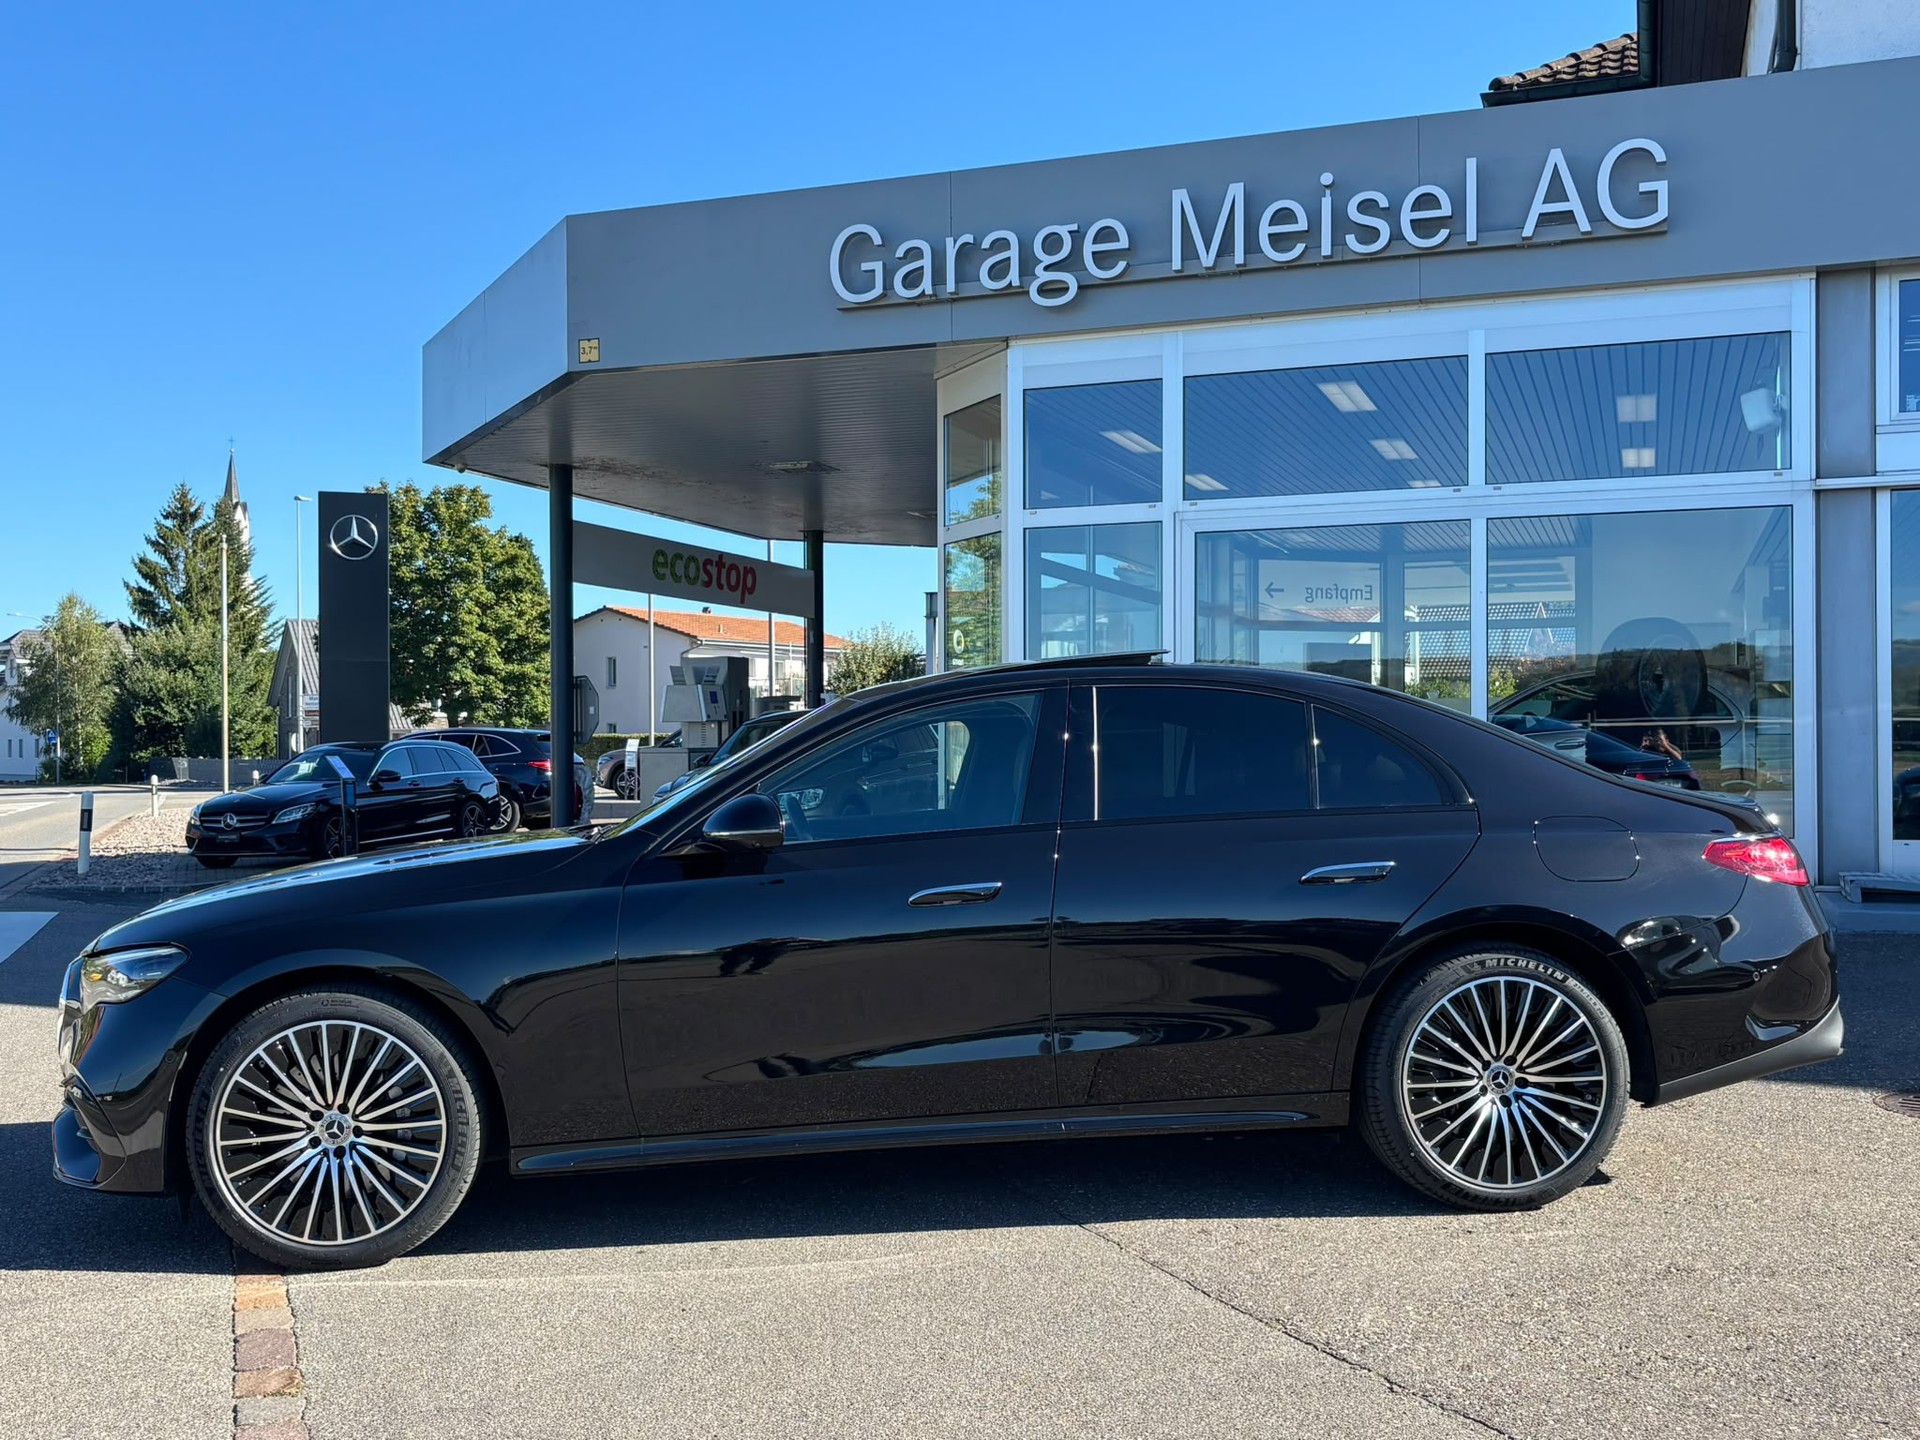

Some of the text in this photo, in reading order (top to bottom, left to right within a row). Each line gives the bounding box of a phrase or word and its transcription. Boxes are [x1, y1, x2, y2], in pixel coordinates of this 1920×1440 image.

[829, 138, 1670, 308] Garage Meisel AG
[652, 549, 757, 605] ecostop
[1485, 957, 1565, 980] MICHELIN
[449, 1076, 468, 1170] MICHELIN
